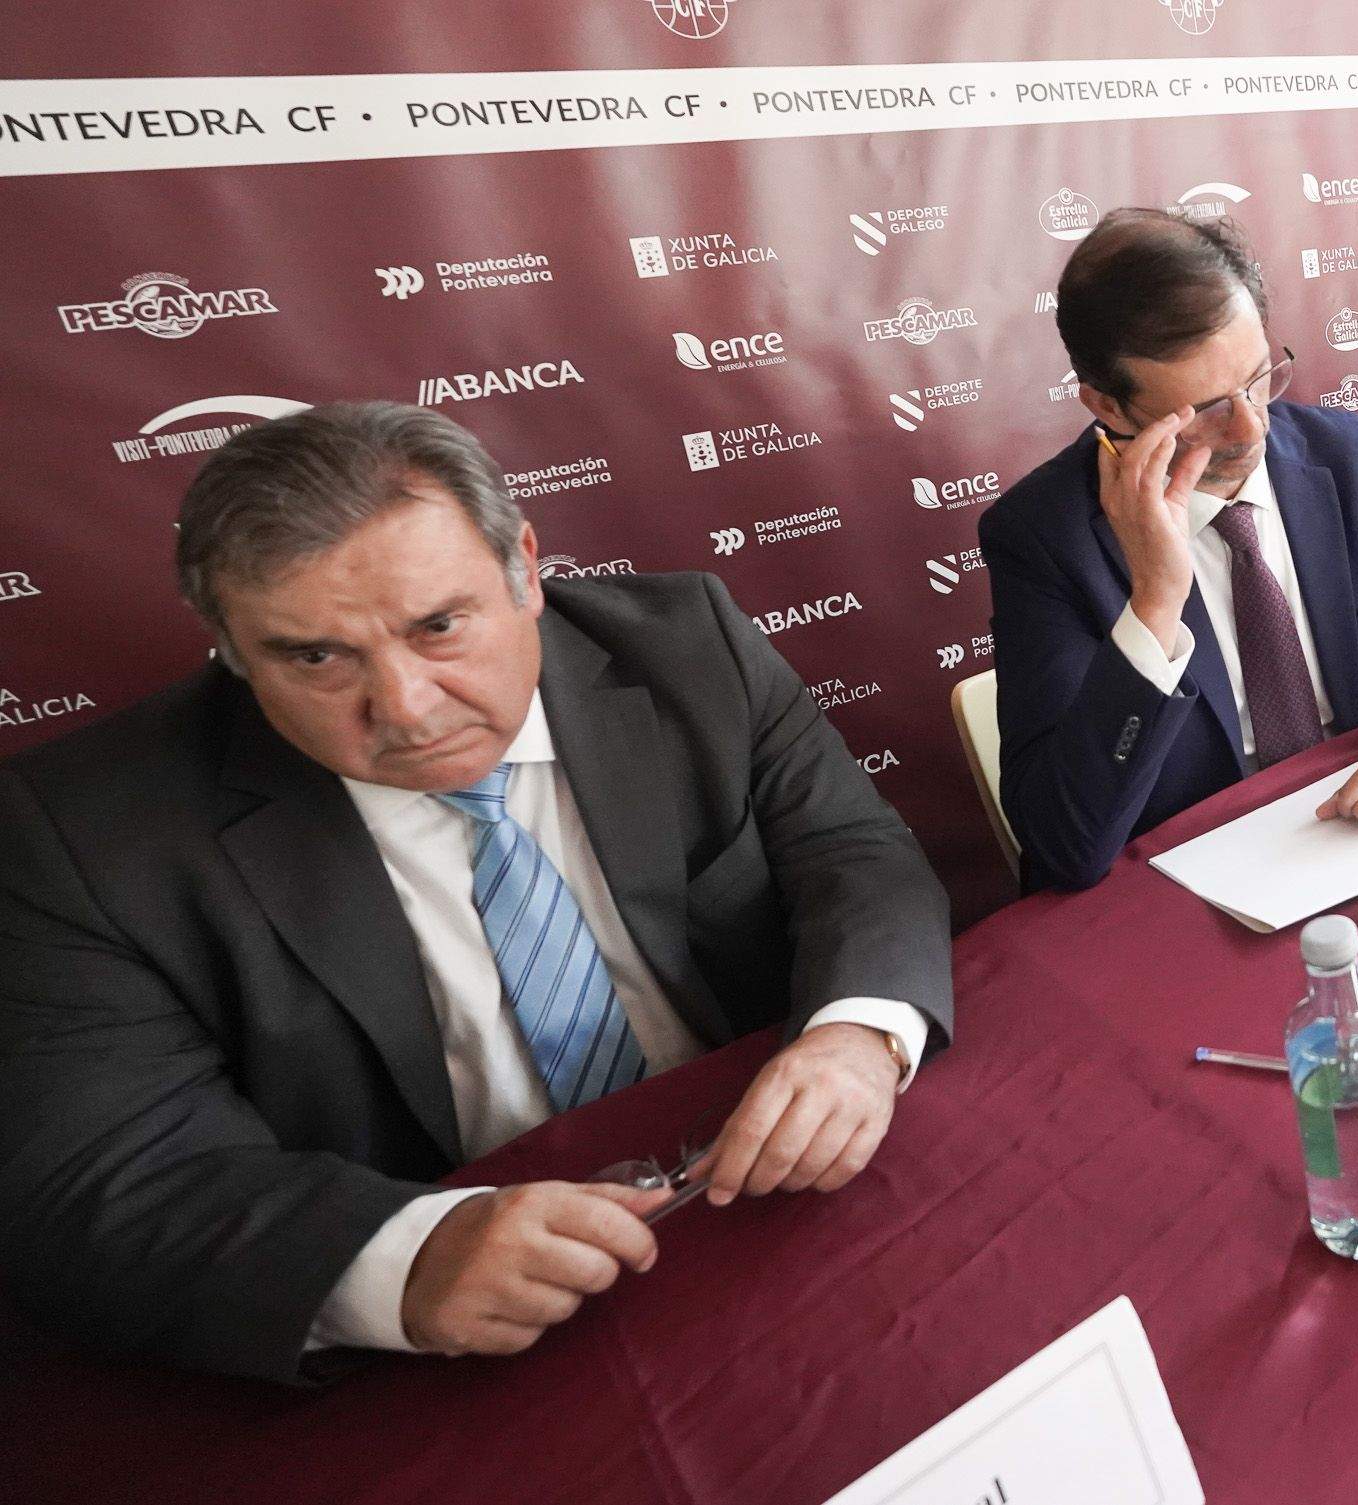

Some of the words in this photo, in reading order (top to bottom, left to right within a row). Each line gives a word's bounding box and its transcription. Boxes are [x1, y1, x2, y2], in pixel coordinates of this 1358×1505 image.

[0, 108, 265, 143] NTEVEDRA
[287, 106, 337, 133] CF
[406, 97, 648, 128] PONTEVEDRA
[665, 95, 701, 118] CF
[753, 86, 936, 114] PONTEVEDRA
[948, 85, 977, 106] CF
[1016, 80, 1159, 103] PONTEVEDRA
[1169, 78, 1192, 97] CF
[1224, 74, 1339, 94] PONTEVEDRA
[887, 205, 949, 221] DEPORTE
[1049, 203, 1088, 217] Estrella
[1052, 215, 1089, 230] Galicia
[890, 218, 945, 235] GALEGO
[668, 233, 736, 254] XUNTA
[1321, 246, 1356, 262] XUNTA
[435, 252, 549, 279] Deputación
[671, 254, 699, 272] DE
[703, 246, 779, 268] GALICIA
[1322, 262, 1337, 274] DE
[441, 268, 554, 293] Pontevedra
[57, 287, 280, 334] PESCAMAR
[864, 307, 978, 342] PESCAMAR
[710, 332, 785, 361] ence
[924, 378, 983, 398] DEPORTE
[927, 391, 979, 410] GALEGO
[719, 422, 783, 445] XUNTA
[722, 447, 747, 462] DE
[752, 431, 822, 456] GALICIA
[503, 456, 608, 487] Deputación
[508, 470, 613, 501] Pontevedra
[941, 471, 1000, 500] ence
[754, 505, 839, 534] Deputación
[757, 517, 842, 546] Pontevedra
[962, 558, 987, 572] GAL
[806, 678, 845, 698] NTA
[818, 681, 882, 710] GALICIA
[0, 692, 97, 726] ALICIA
